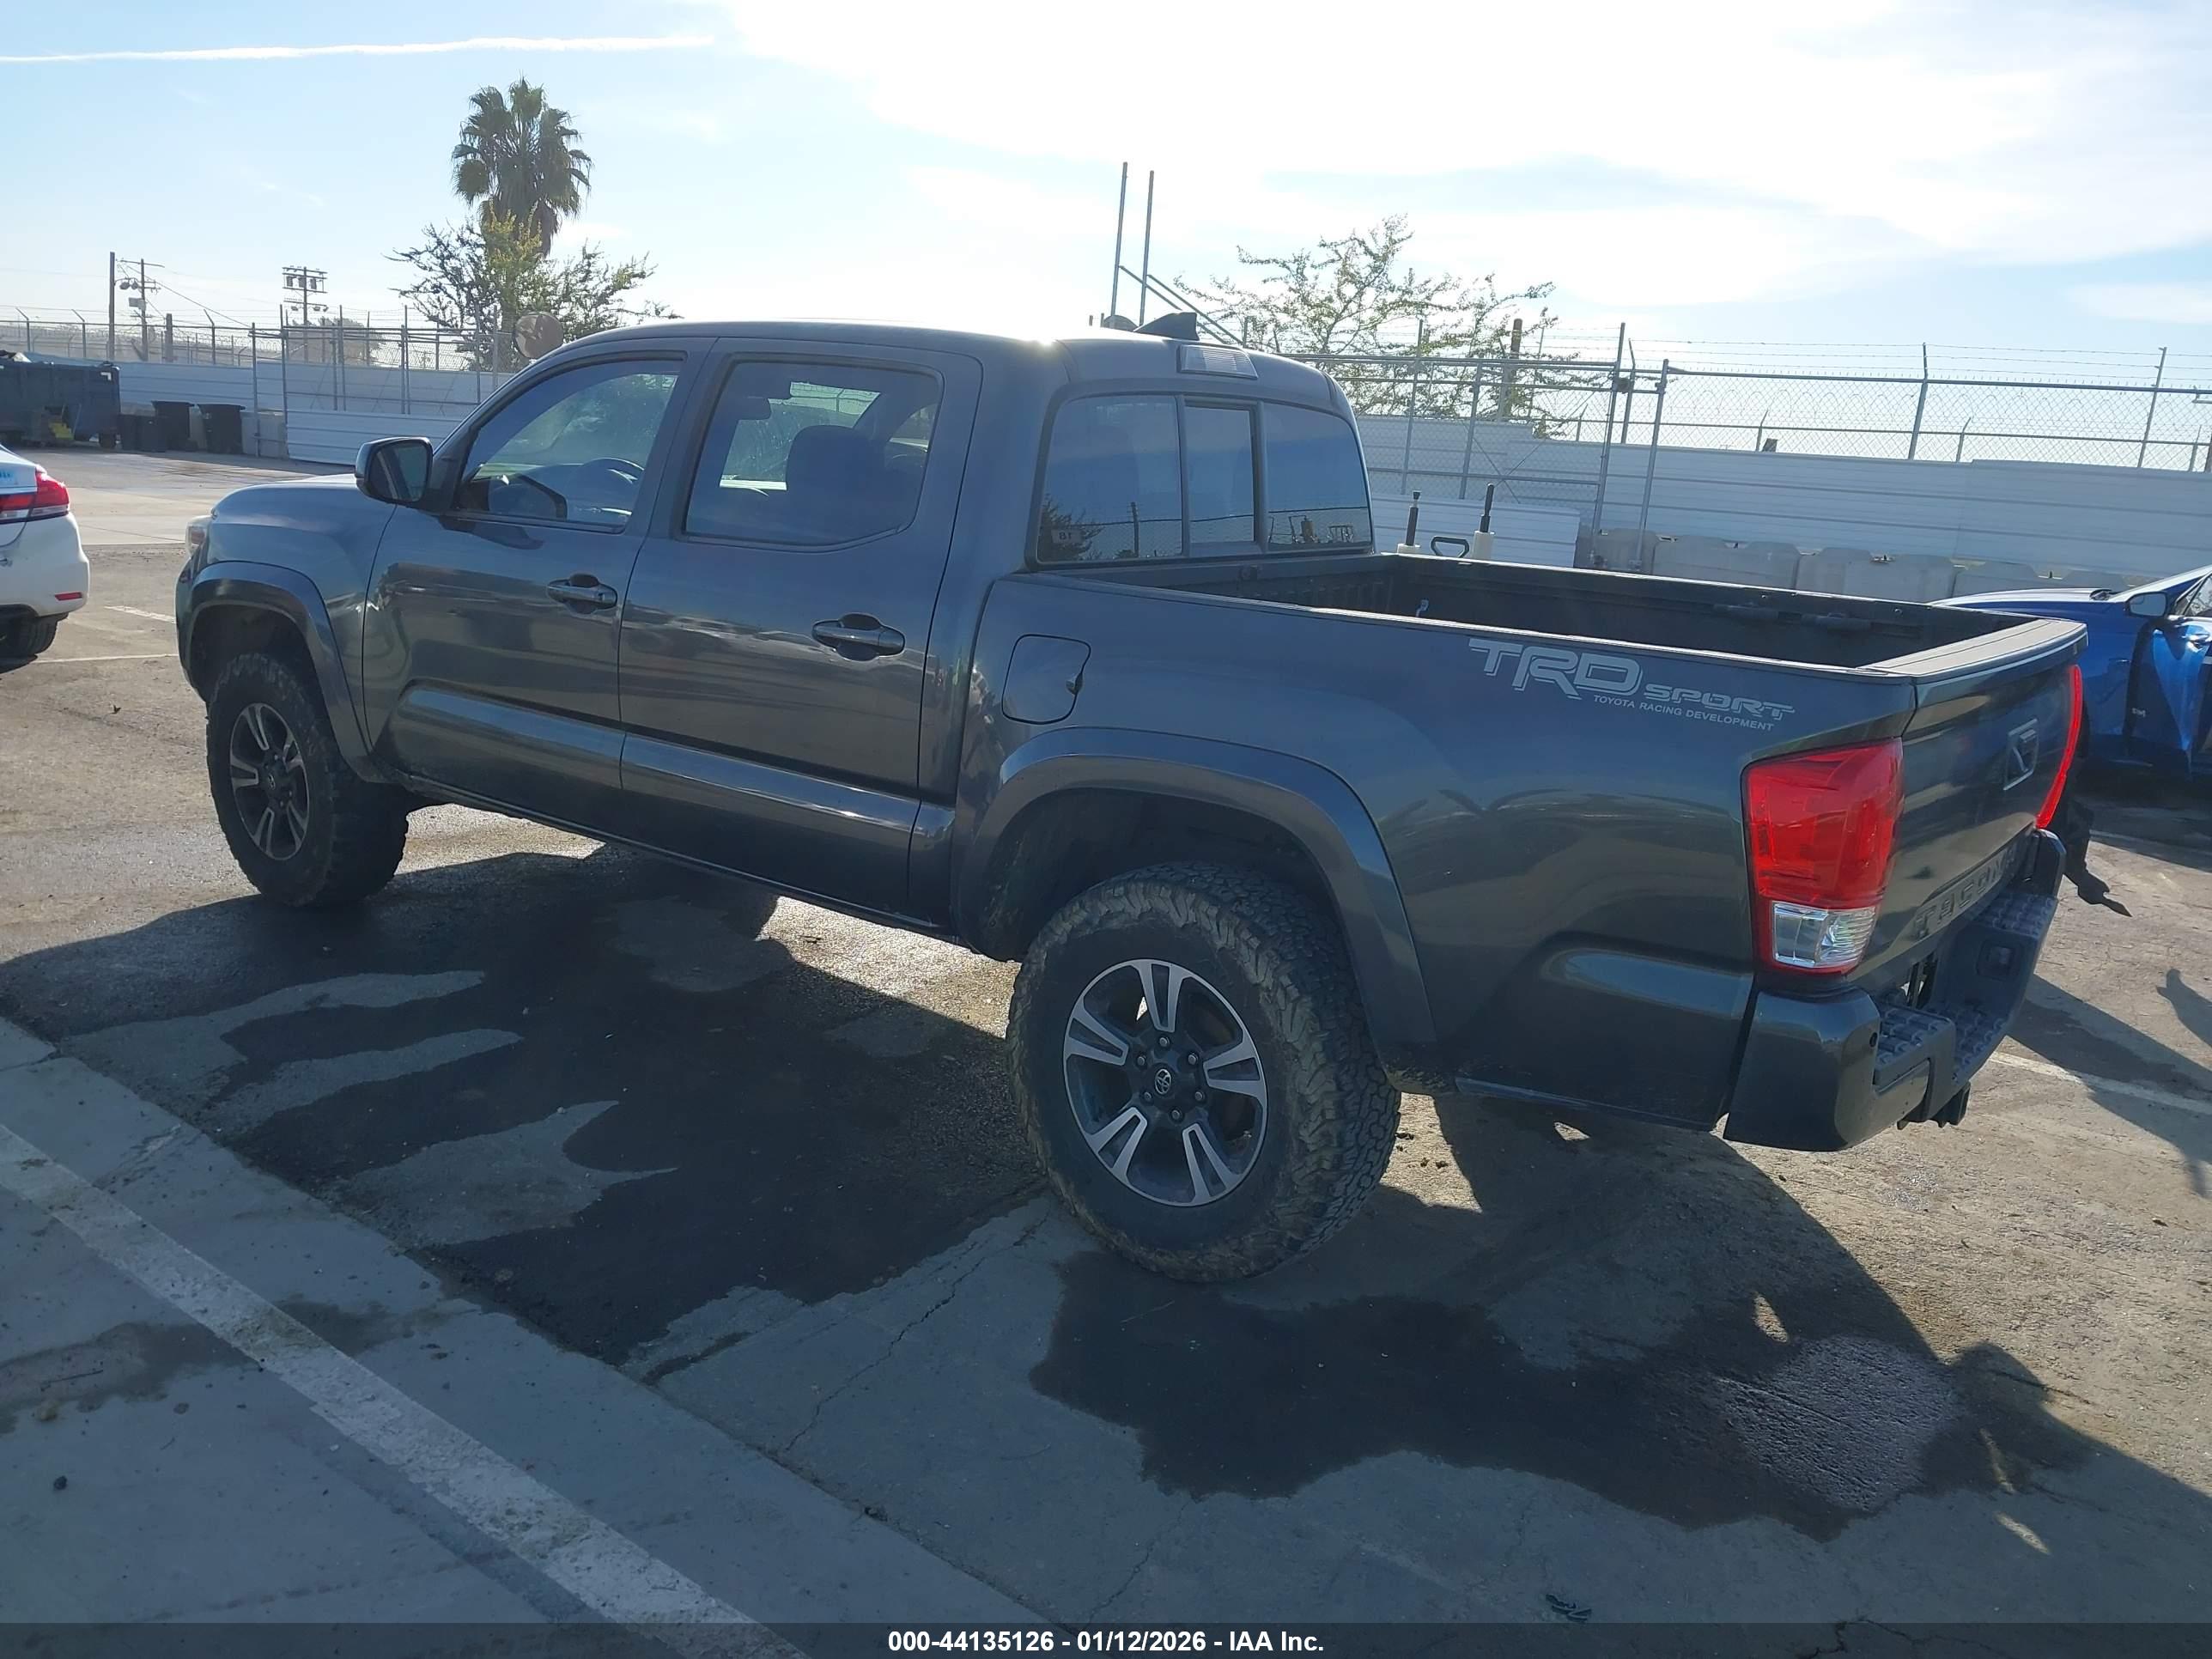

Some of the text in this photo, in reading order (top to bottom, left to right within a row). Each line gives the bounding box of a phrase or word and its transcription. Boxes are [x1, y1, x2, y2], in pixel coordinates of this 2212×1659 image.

[1468, 638, 1796, 720] TRD SPORT
[1593, 694, 1775, 731] TOYOTA RACING DEVELOPMENT
